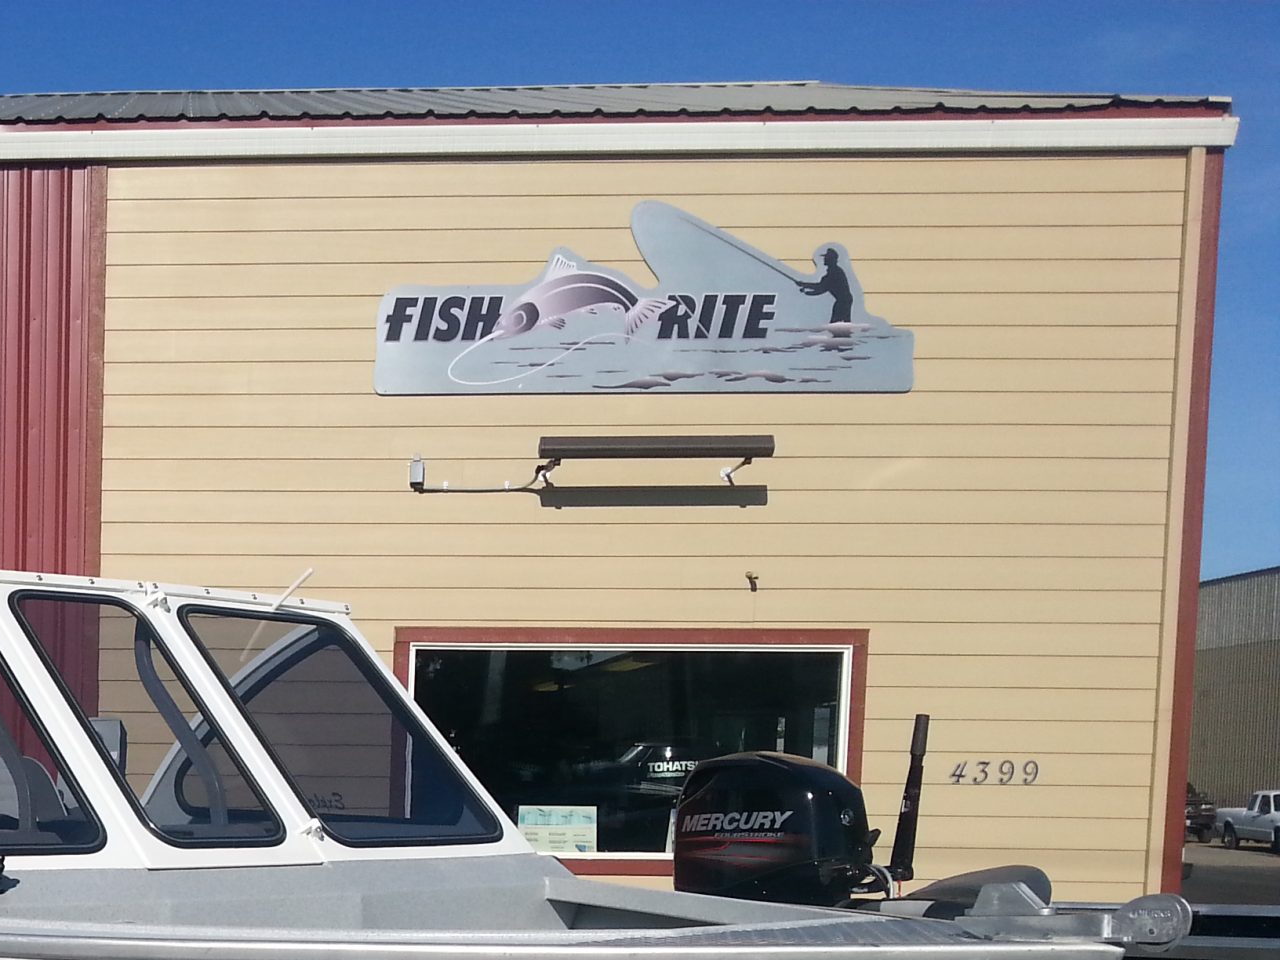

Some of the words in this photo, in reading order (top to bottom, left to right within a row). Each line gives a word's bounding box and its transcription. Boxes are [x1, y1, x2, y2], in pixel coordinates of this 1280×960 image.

[385, 296, 504, 341] FISH
[657, 294, 775, 339] RITE
[647, 761, 698, 772] TOHATS
[950, 760, 1038, 785] 4399
[682, 811, 793, 832] MERCURY
